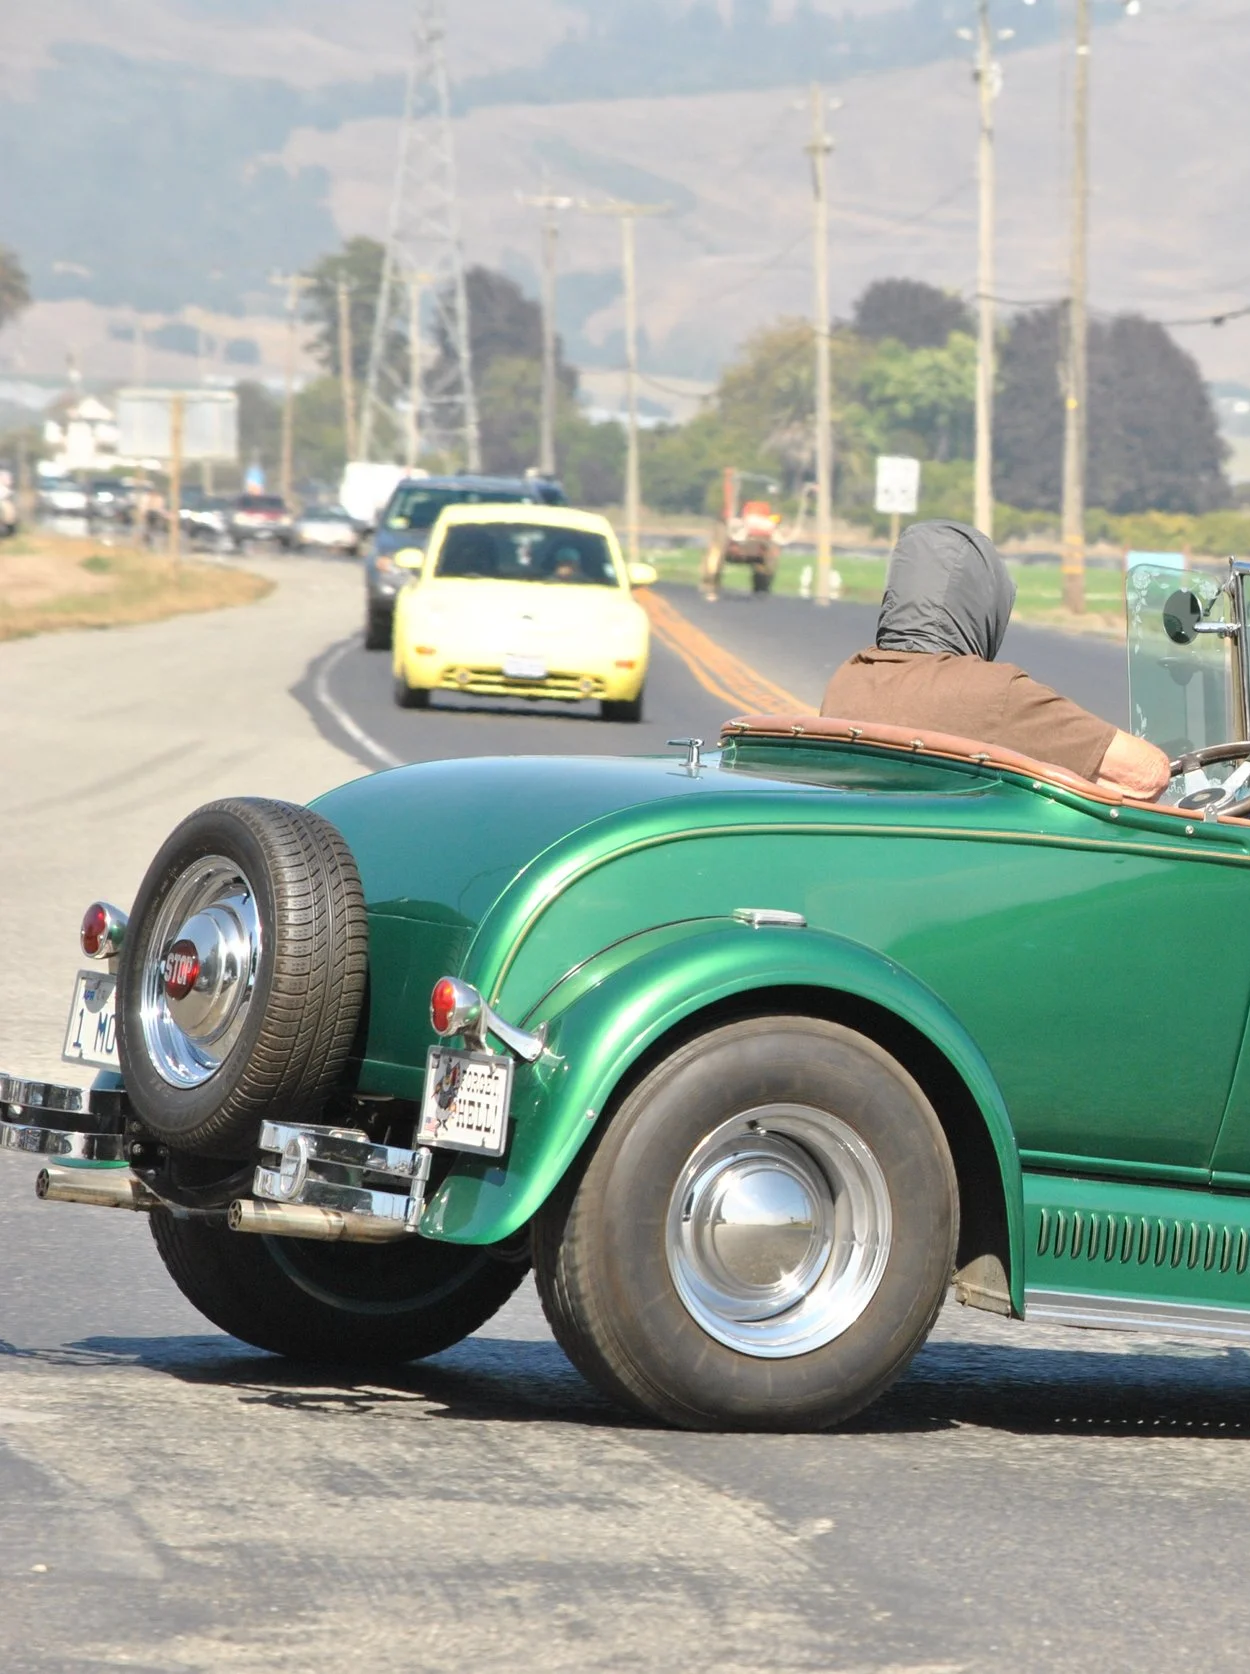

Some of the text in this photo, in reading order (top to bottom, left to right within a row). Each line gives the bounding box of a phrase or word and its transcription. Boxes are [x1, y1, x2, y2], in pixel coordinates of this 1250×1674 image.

[164, 953, 193, 985] STOP
[72, 1008, 84, 1049] 1
[456, 1099, 498, 1134] HELL!
